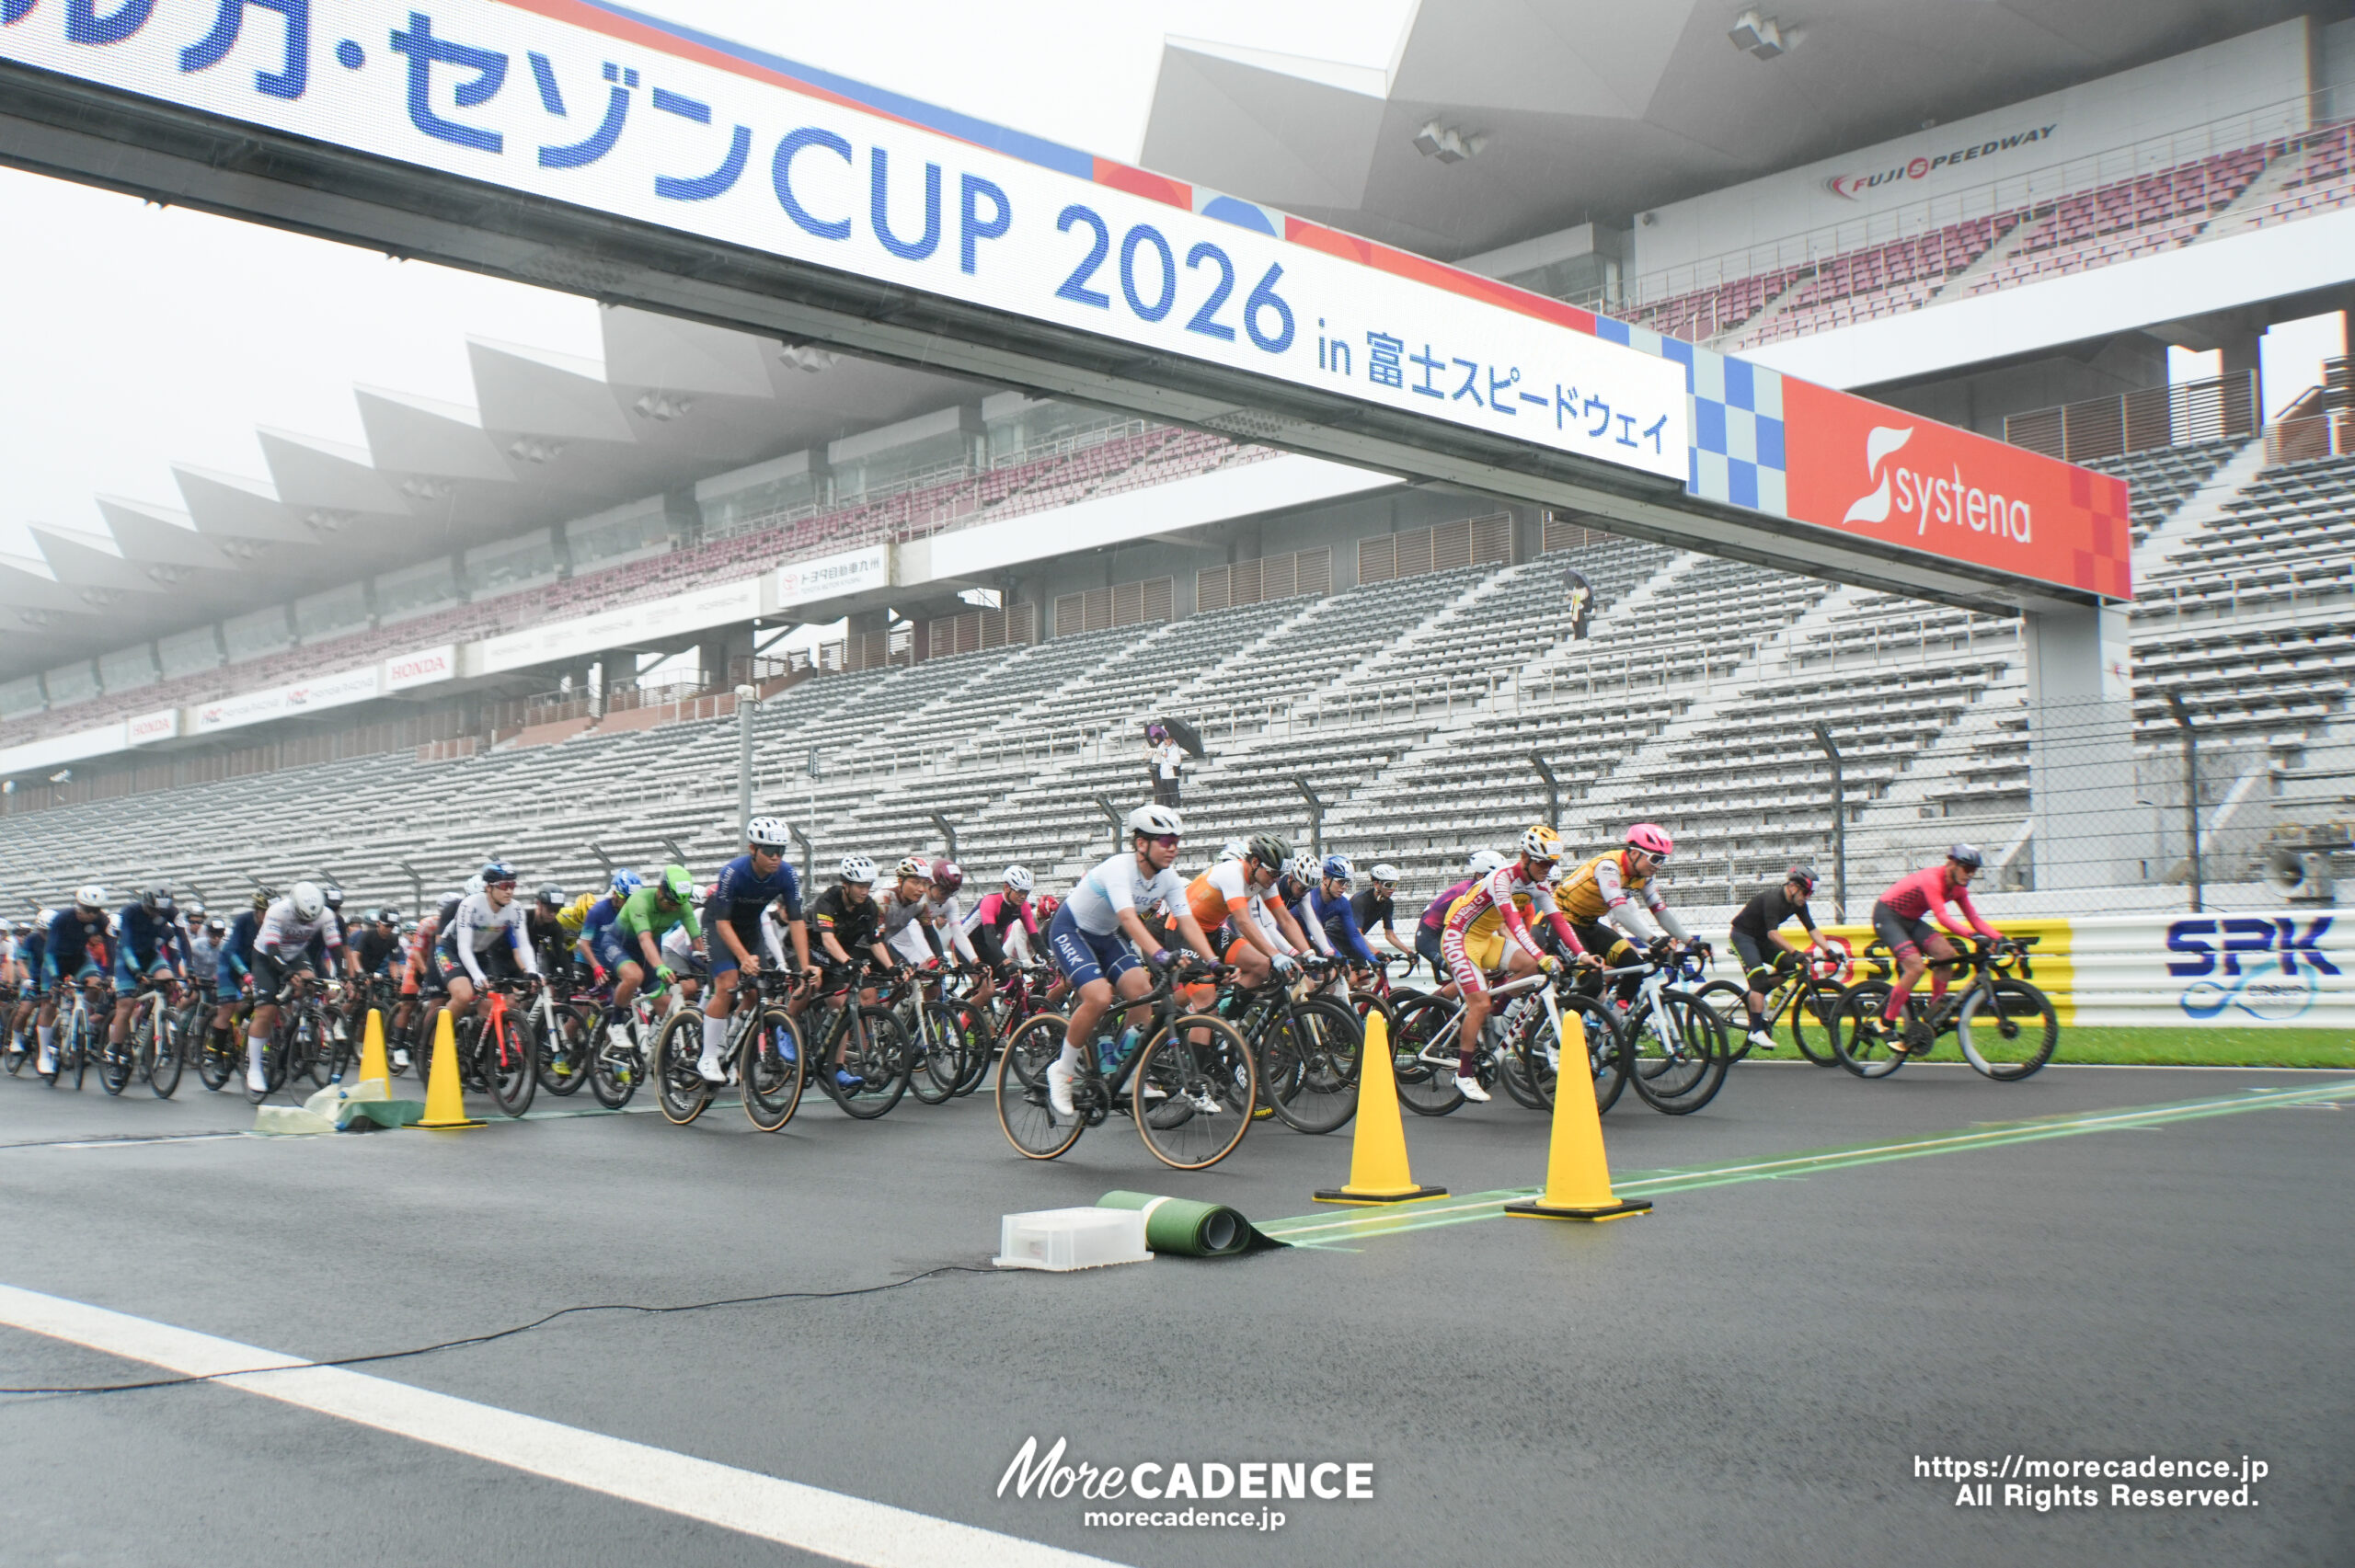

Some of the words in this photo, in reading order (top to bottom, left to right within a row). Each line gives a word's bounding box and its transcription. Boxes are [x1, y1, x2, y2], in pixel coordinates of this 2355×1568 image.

[1853, 166, 1905, 192] FUJI
[1055, 203, 1296, 354] 2026
[1318, 317, 1351, 376] in
[1367, 331, 1668, 454] 富士スピードウェイ
[391, 657, 446, 680] HONDA
[1054, 934, 1085, 967] PARK
[2165, 917, 2342, 977] SPK
